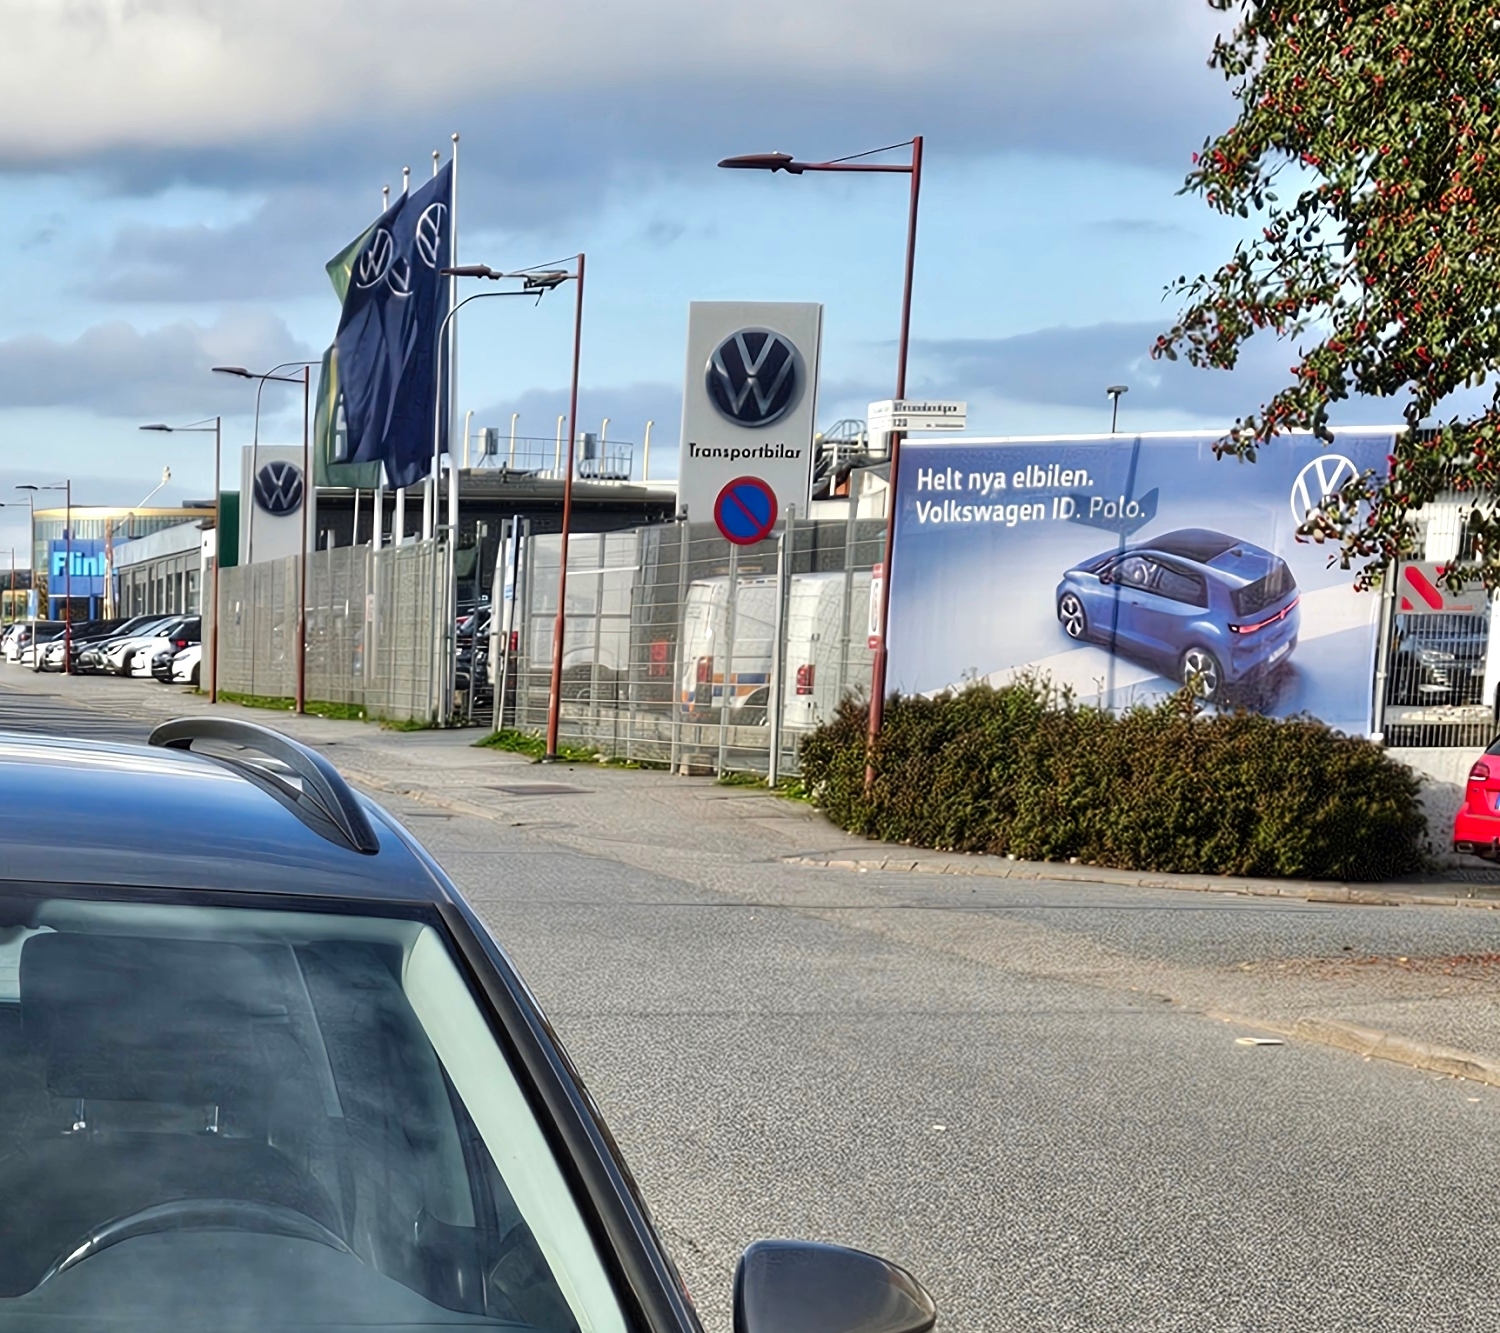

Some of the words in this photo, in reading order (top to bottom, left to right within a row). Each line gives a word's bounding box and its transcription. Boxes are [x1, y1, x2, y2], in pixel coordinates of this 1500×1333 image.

[706, 327, 801, 428] VW
[689, 442, 802, 461] Transportbilar
[917, 467, 963, 491] Helt
[968, 471, 1007, 495] nya
[1013, 464, 1094, 489] elbilen.
[916, 499, 1046, 527] Volkswagen
[1052, 497, 1081, 520] ID.
[1089, 495, 1146, 519] Polo.
